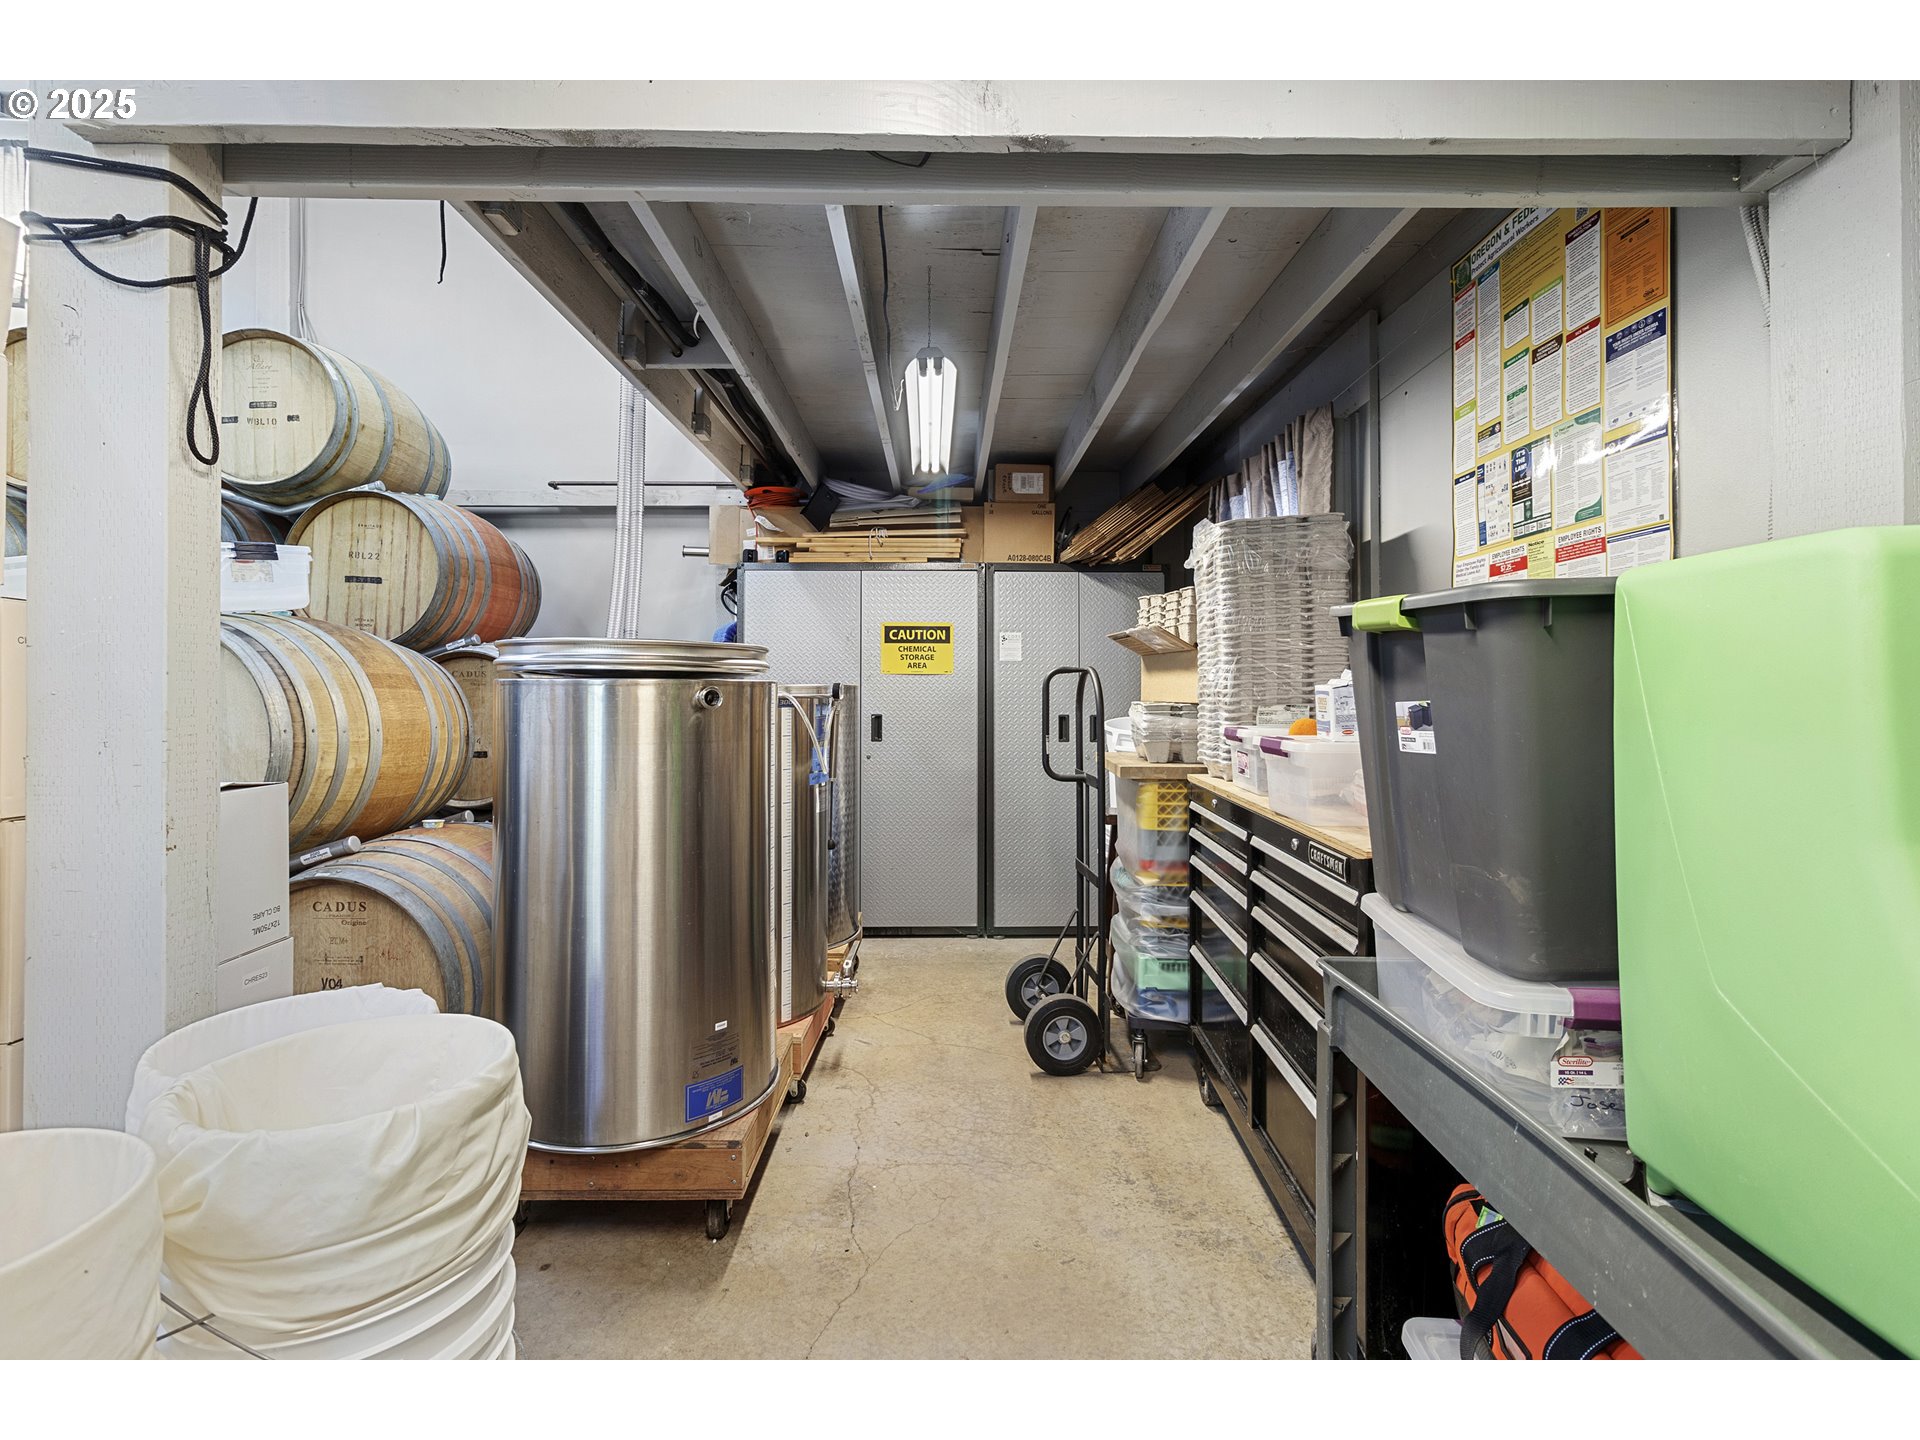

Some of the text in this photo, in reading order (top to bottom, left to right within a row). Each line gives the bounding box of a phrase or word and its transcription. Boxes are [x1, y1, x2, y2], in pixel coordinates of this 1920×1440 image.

[1487, 232, 1515, 262] Agricultural
[1515, 214, 1540, 237] Workers
[1471, 229, 1502, 265] OREGON
[1557, 531, 1583, 544] EMPLOYEE
[1582, 526, 1602, 537] RIGHTS
[1491, 549, 1511, 560] EMPLOYEE
[1511, 545, 1526, 555] RIGHTS
[889, 629, 946, 641] CAUTION
[897, 645, 937, 653] CHEMICAL
[900, 653, 935, 661] STORAGE
[451, 670, 487, 679] CADUS
[1310, 848, 1344, 875] CRAFTSMAN
[312, 900, 368, 912] CADUS
[252, 908, 273, 921] CLAIRE
[341, 919, 367, 927] Origine
